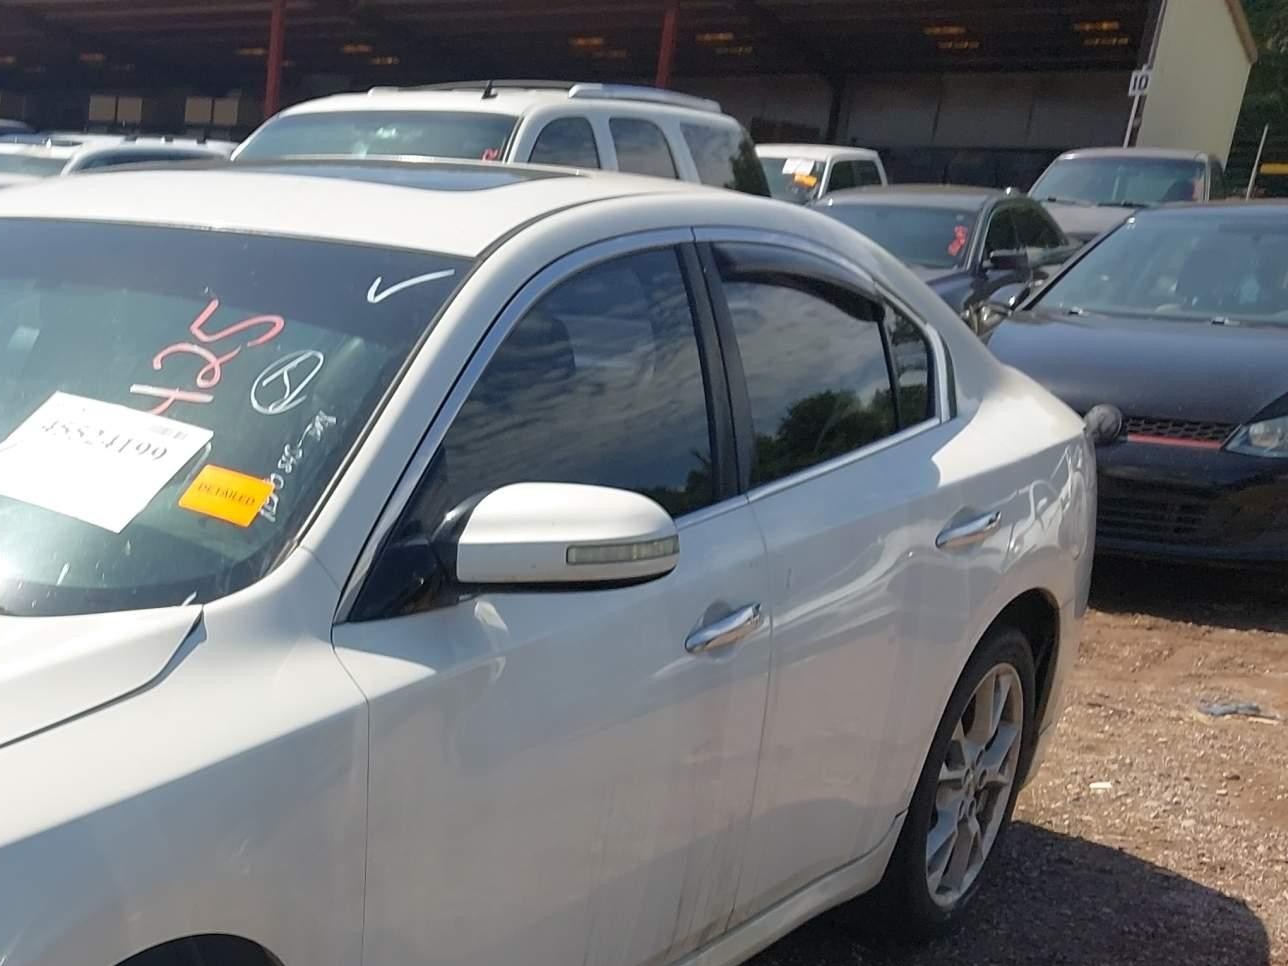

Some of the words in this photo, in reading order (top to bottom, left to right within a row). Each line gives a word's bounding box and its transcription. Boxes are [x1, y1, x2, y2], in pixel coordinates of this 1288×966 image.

[1132, 74, 1150, 91] 10
[130, 298, 285, 416] 425
[197, 481, 257, 508] DETAILED
